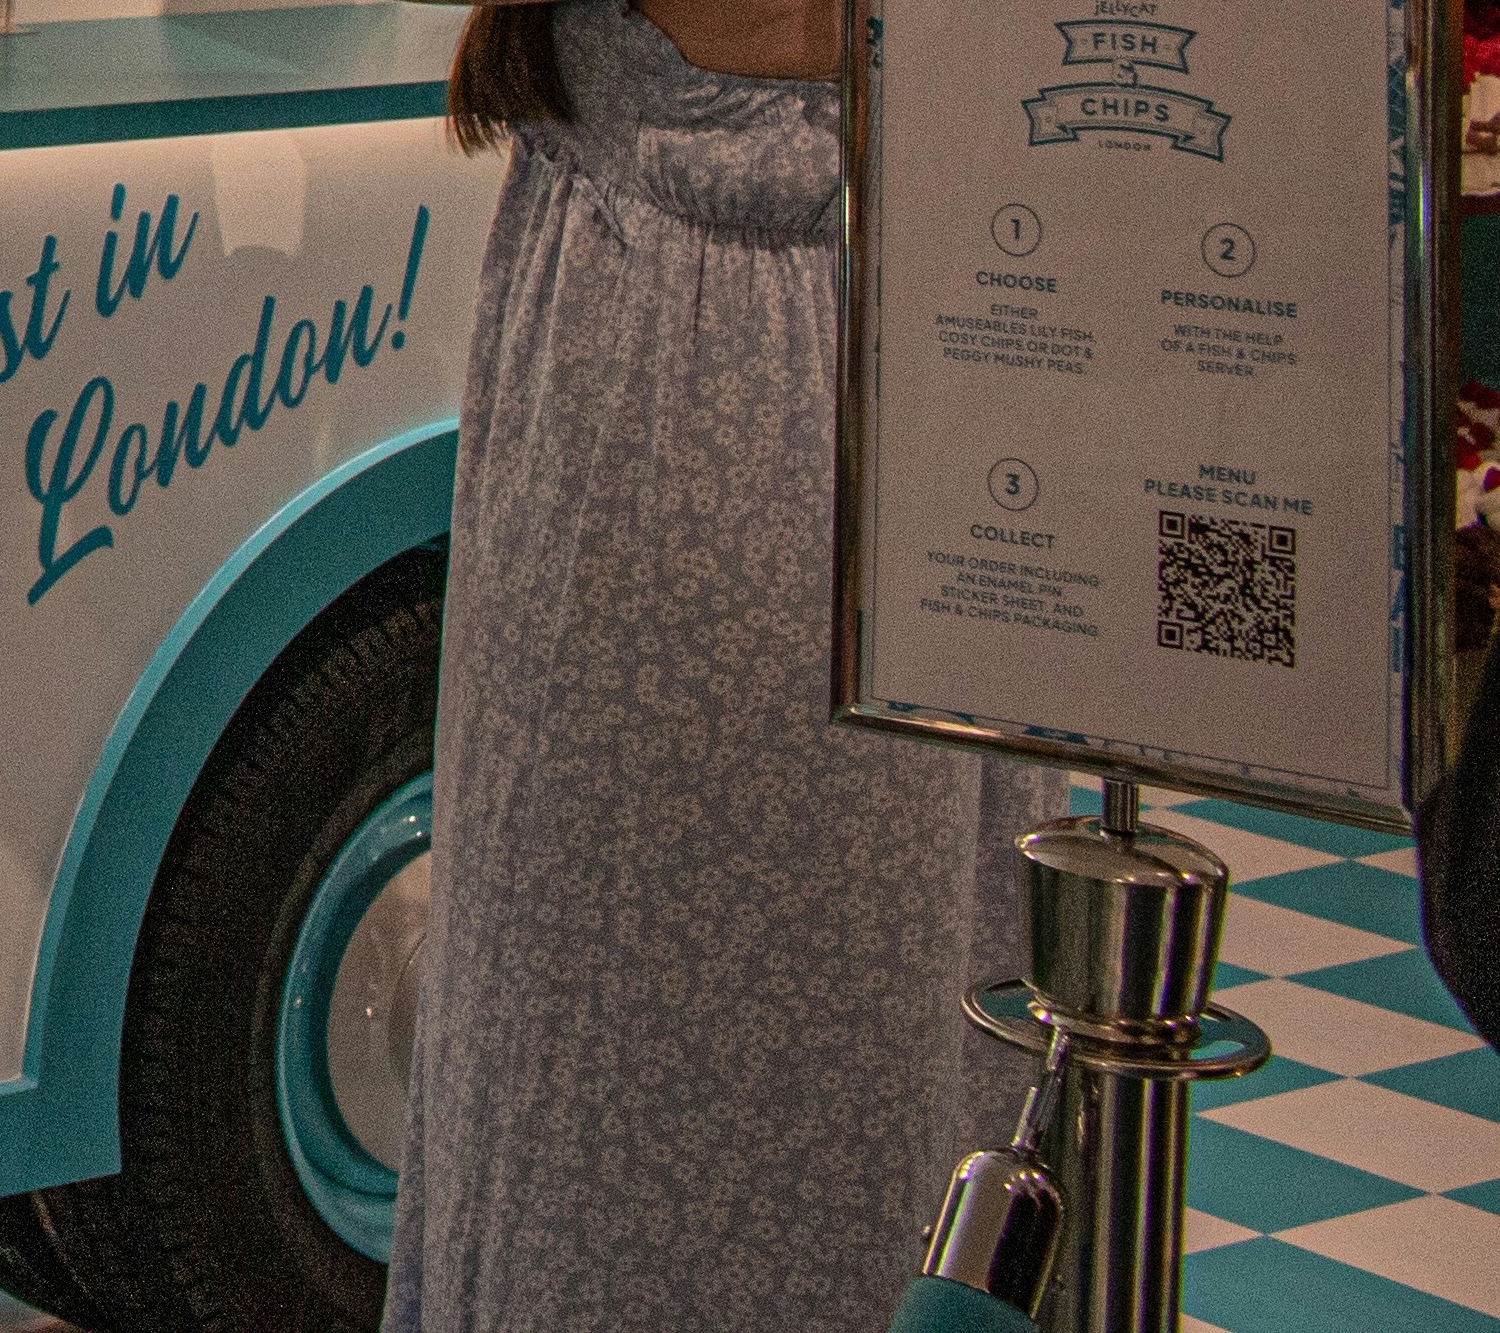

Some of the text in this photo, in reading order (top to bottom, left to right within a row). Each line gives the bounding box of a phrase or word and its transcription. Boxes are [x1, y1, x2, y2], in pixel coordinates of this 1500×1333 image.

[1092, 32, 1159, 54] FISH
[1080, 97, 1171, 123] CHIPS
[1097, 139, 1152, 153] LONDON
[95, 182, 200, 320] in
[1219, 237, 1237, 262] 2
[974, 270, 1058, 294] CHOOSE
[990, 303, 1039, 321] EITHER
[1160, 288, 1298, 320] PERSONALISE
[935, 313, 1028, 336] AMUSEABLES
[1173, 323, 1284, 347] WITH THE HELP
[938, 330, 977, 345] COSY
[980, 335, 1023, 352] CHIPS
[1026, 340, 1049, 355] OR
[1050, 343, 1081, 358] DOT
[1159, 338, 1182, 353] OF
[1198, 342, 1233, 359] FISH
[1249, 349, 1298, 366] CHIPS
[943, 347, 991, 363] PEGGY
[993, 353, 1044, 370] MUSHY
[26, 204, 431, 607] London!
[1004, 472, 1021, 497] 3
[1197, 463, 1257, 486] MENU
[1143, 477, 1314, 517] PLEASE SCAN ME
[969, 523, 1056, 550] COLLECT
[926, 550, 1102, 589] YOUR ORDER INCLUDING
[956, 571, 976, 585] AN
[978, 575, 1035, 595] ENAMEL
[940, 584, 998, 605] STICKER
[1052, 602, 1085, 618] AND
[919, 597, 952, 614] FISH
[967, 605, 1011, 623] CHIPS
[1013, 611, 1099, 638] PACKAGING
